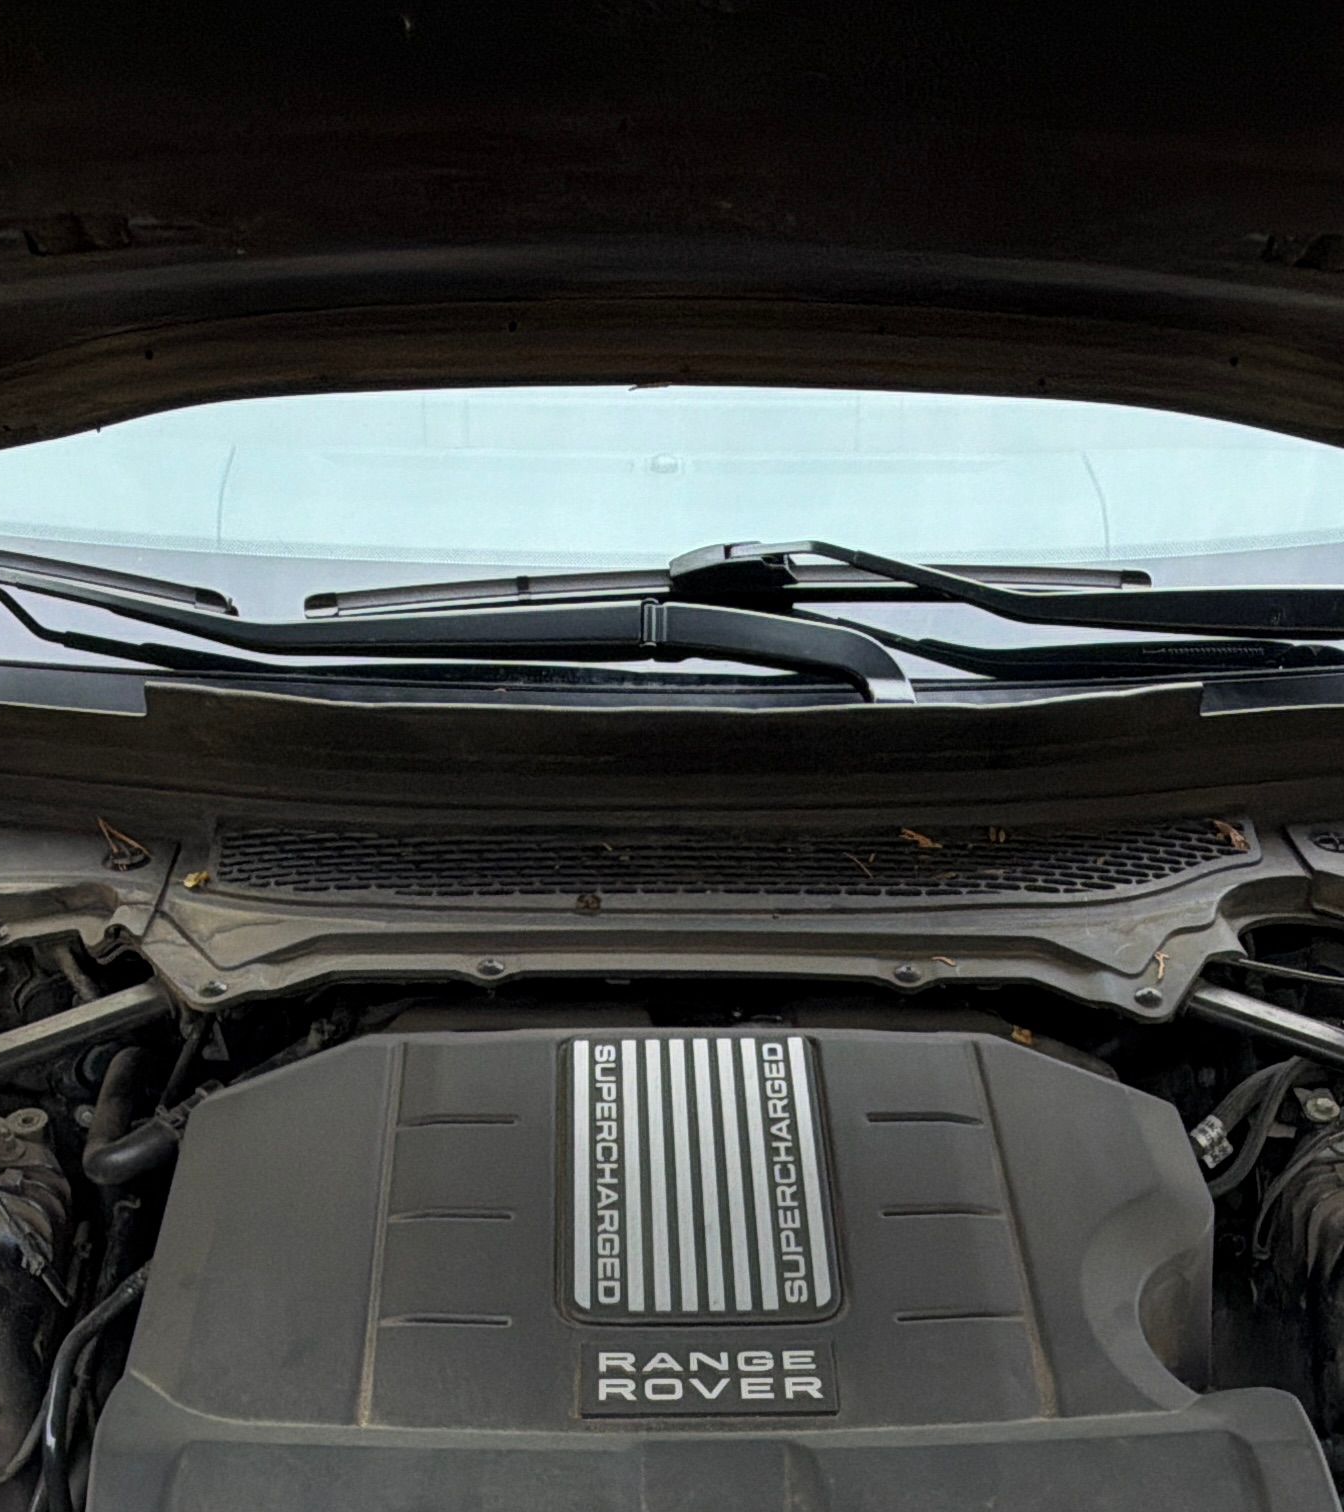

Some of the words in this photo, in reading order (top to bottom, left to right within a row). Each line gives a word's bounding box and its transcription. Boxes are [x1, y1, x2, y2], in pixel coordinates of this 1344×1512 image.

[594, 1044, 621, 1305] SUPERCHARGED
[762, 1043, 808, 1303] SUPERCHARGED
[598, 1350, 817, 1372] RANGE
[598, 1377, 824, 1401] ROVER
